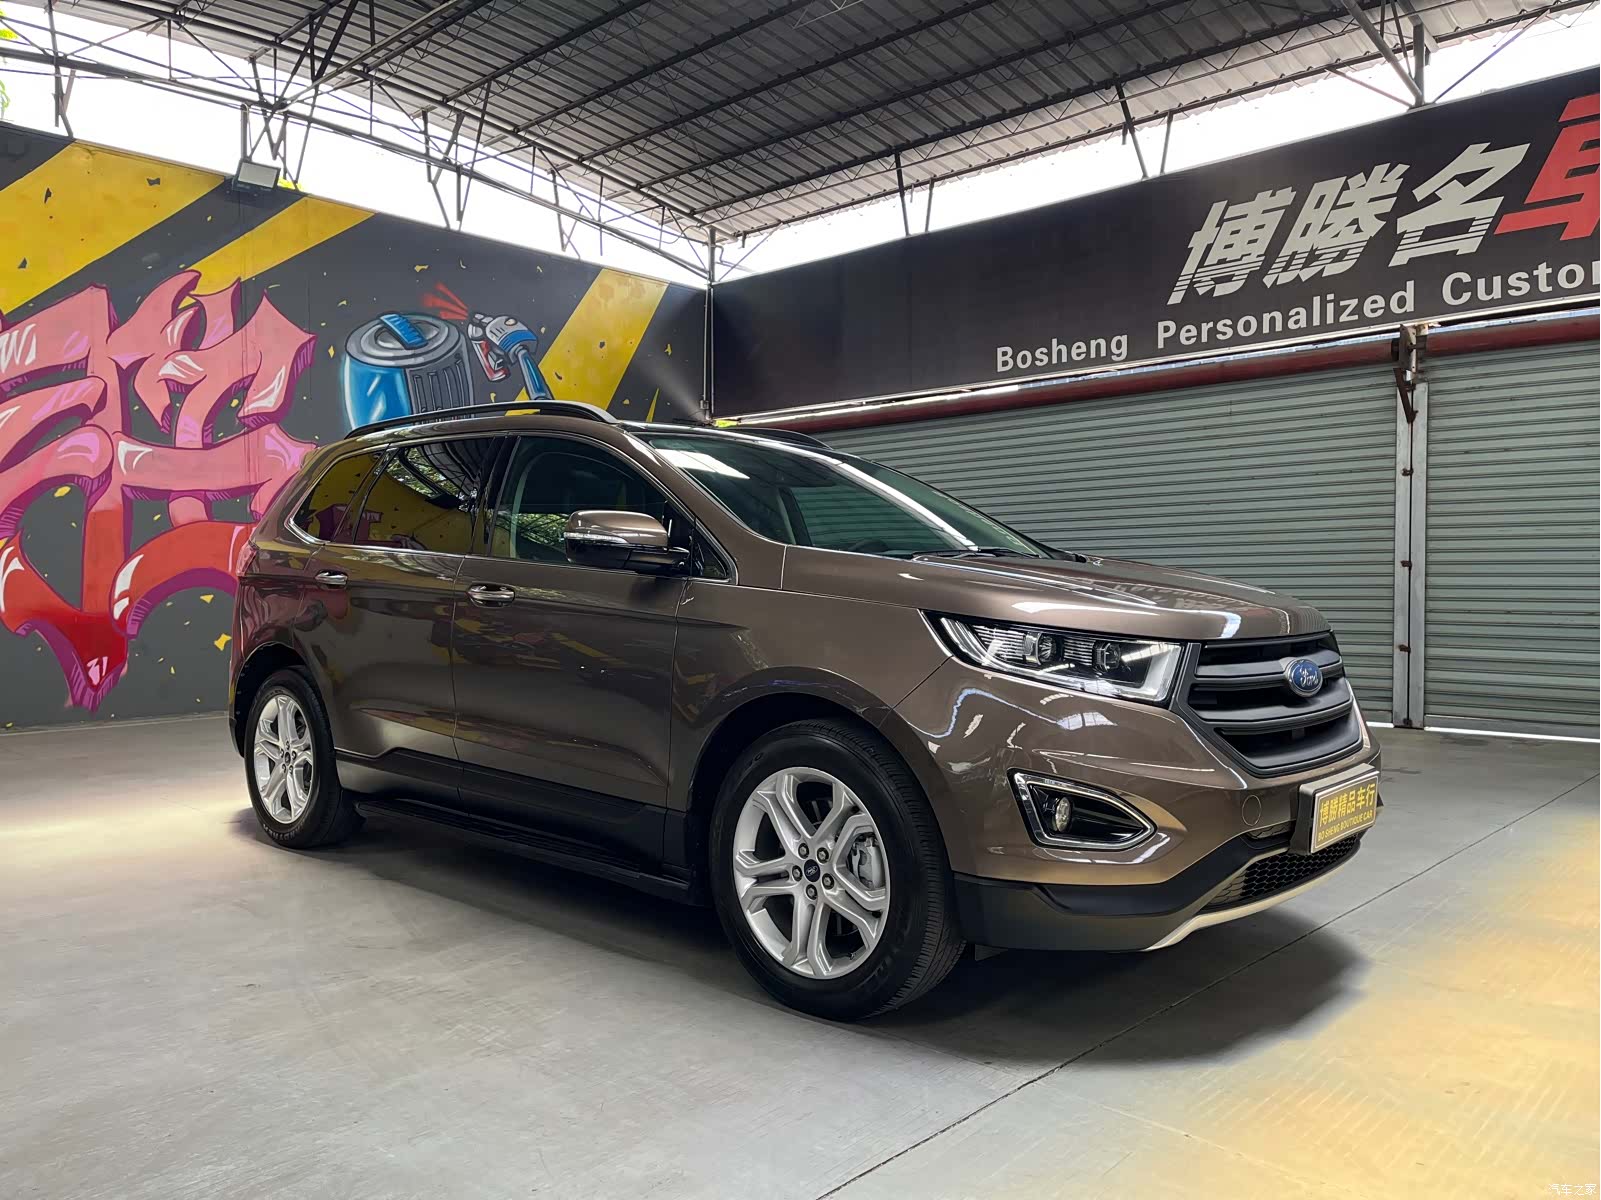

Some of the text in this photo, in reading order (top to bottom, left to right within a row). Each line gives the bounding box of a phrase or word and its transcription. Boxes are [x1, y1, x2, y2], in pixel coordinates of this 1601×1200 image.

[996, 333, 1129, 372] Bosheng
[1157, 282, 1416, 349] Personalized
[1297, 664, 1319, 687] Ford
[1340, 813, 1364, 830] BOUTIQUE
[1363, 810, 1373, 820] CAR
